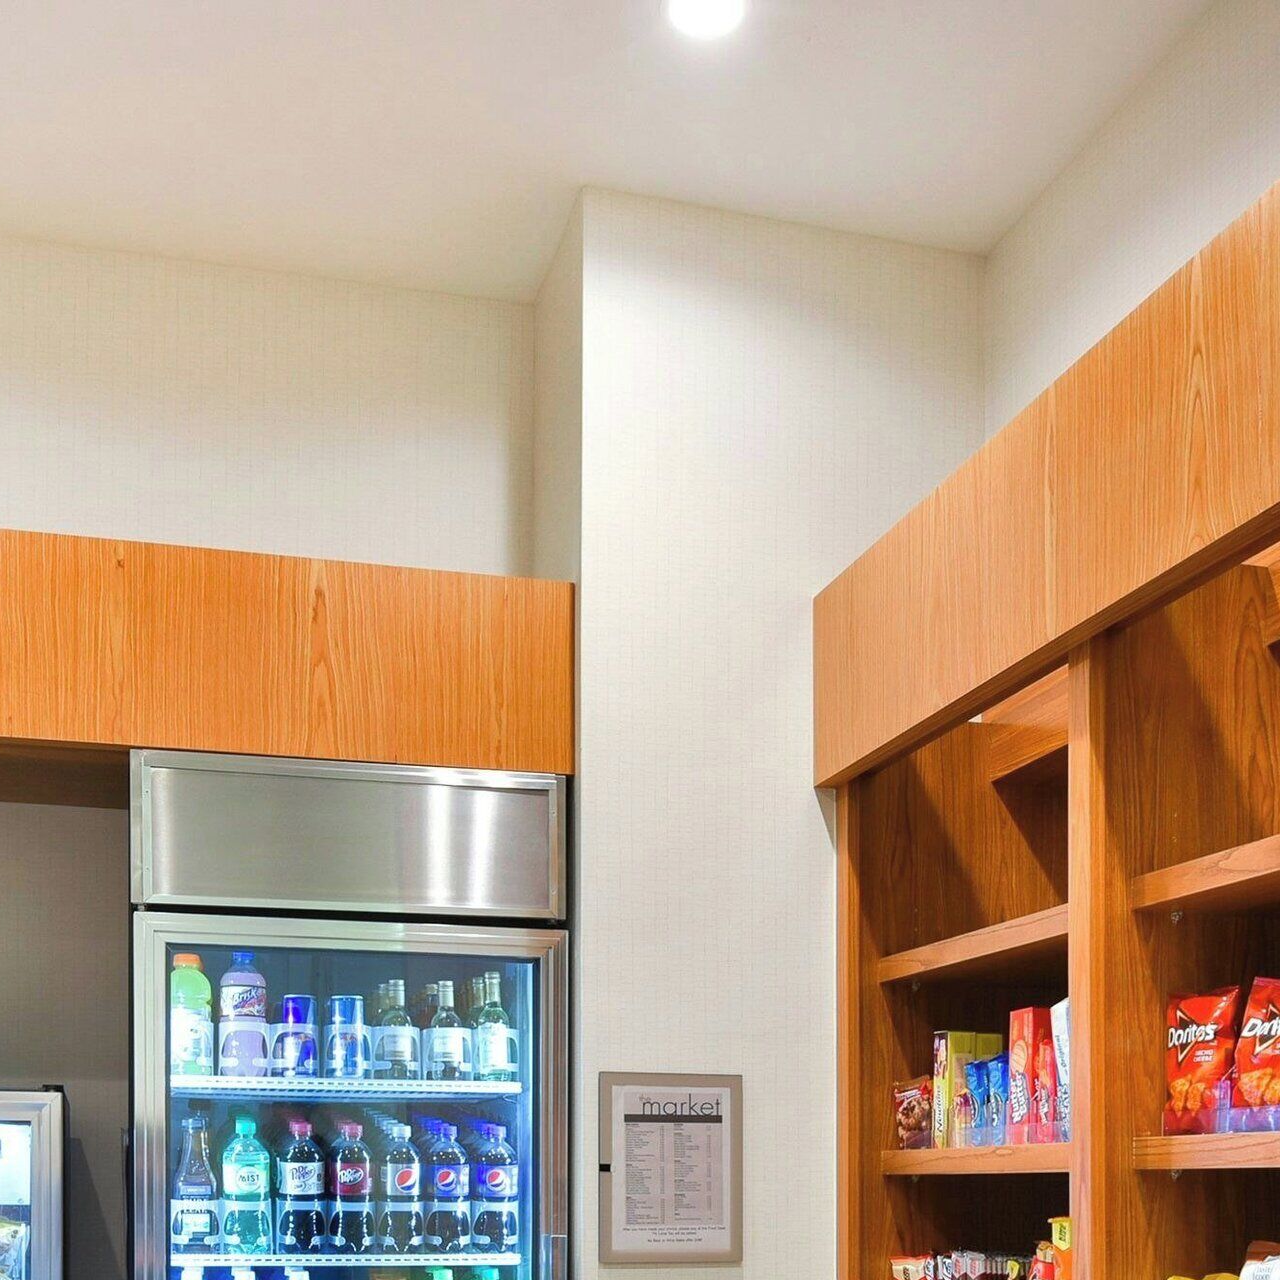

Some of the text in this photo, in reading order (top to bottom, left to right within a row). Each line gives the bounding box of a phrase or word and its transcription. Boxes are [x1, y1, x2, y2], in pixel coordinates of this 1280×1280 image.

[1168, 1022, 1219, 1048] Doritos
[642, 1093, 721, 1116] market
[935, 1084, 946, 1133] Newtons
